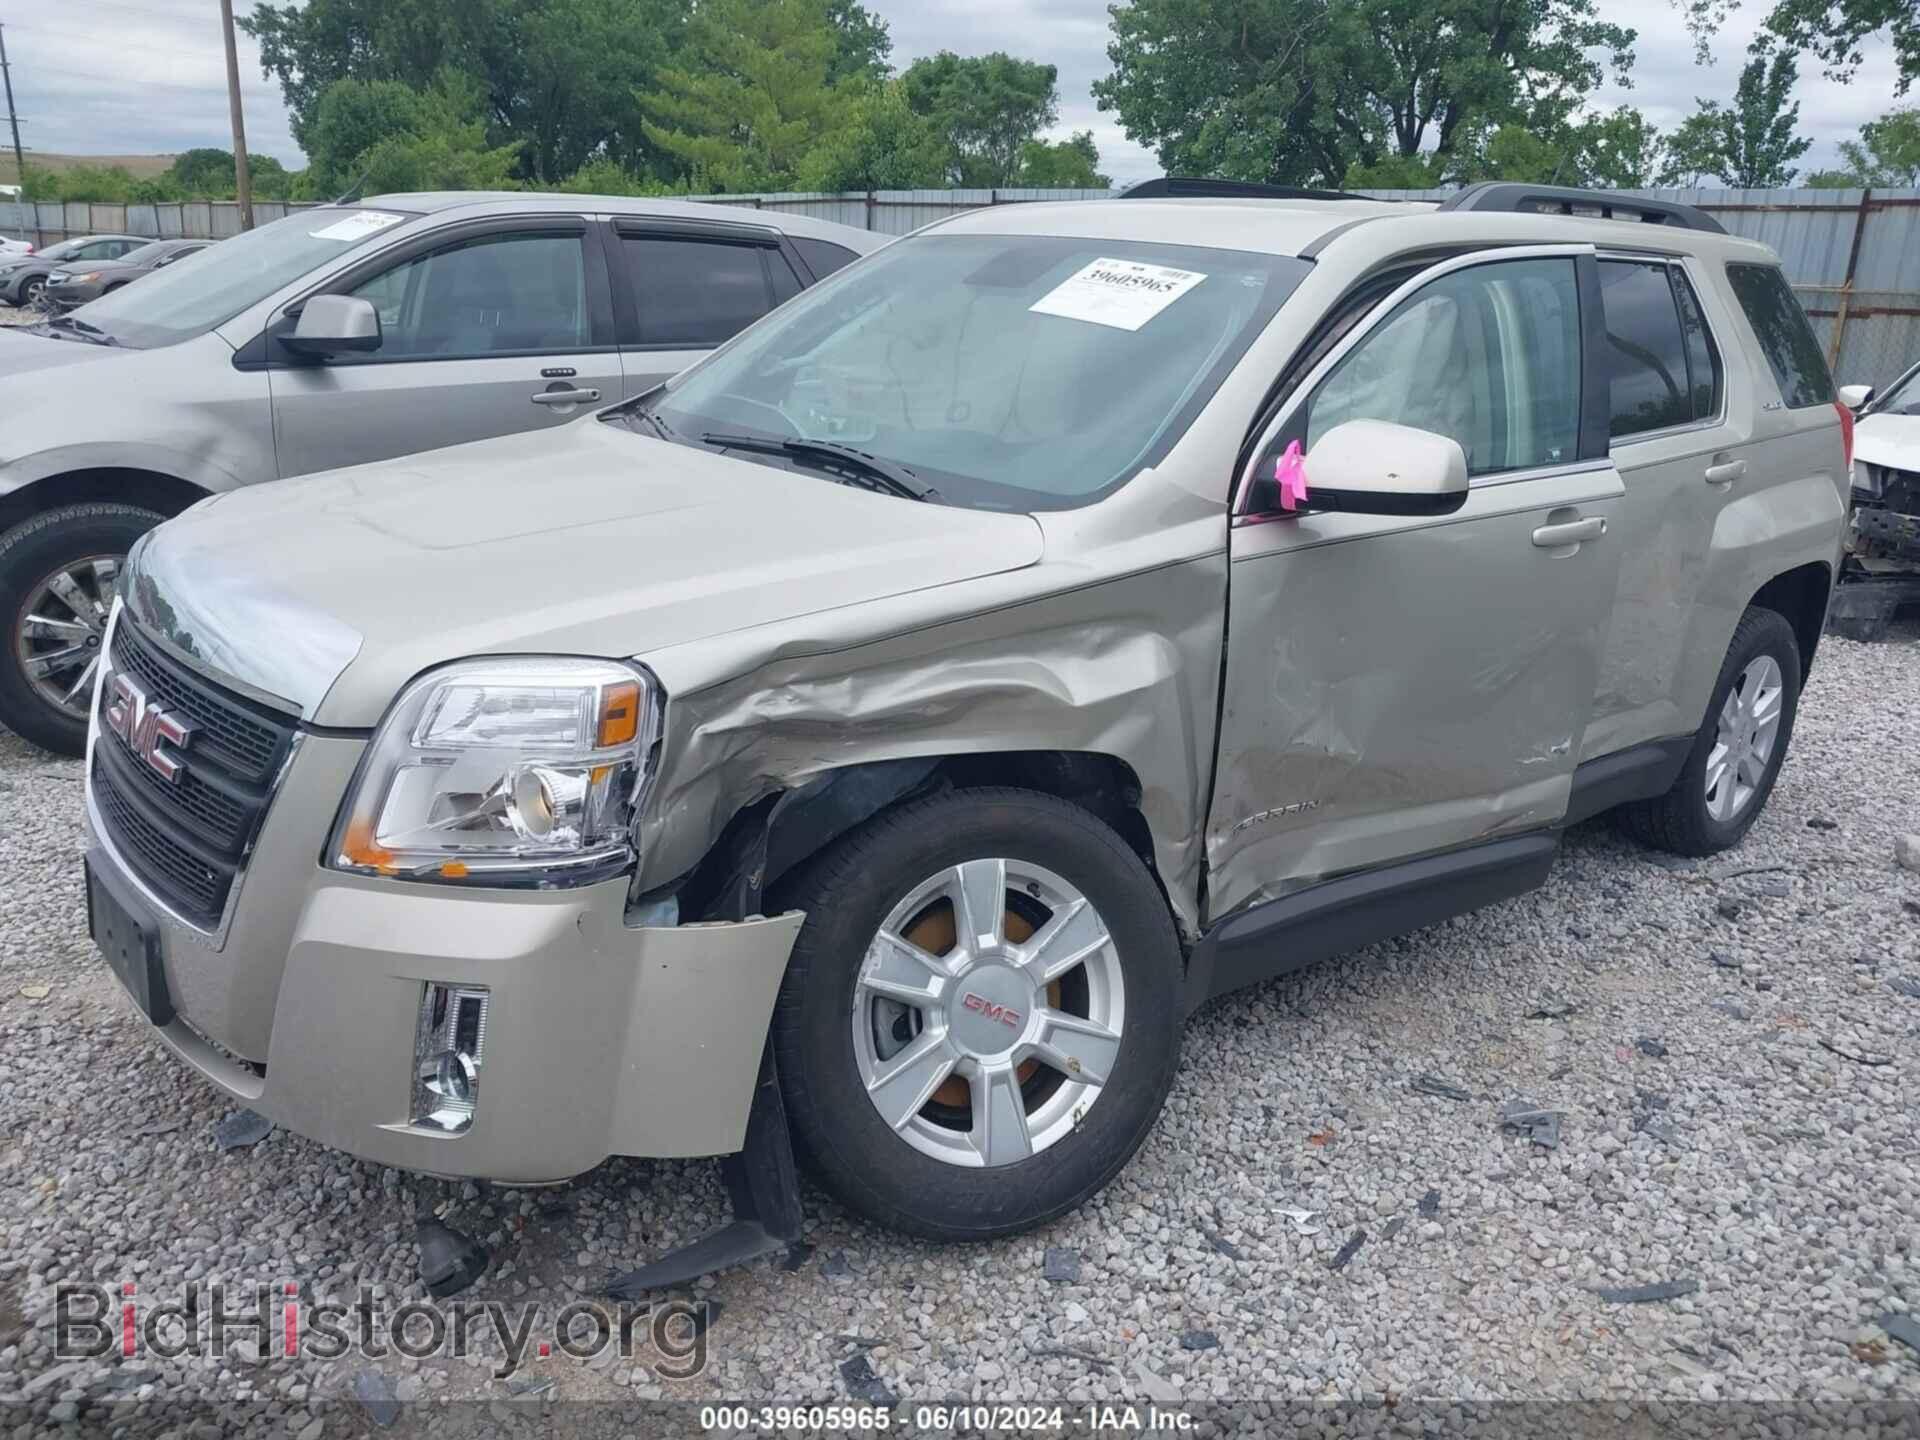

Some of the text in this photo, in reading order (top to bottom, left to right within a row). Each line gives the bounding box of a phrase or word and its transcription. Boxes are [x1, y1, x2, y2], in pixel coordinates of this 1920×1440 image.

[1083, 269, 1177, 293] 39605965
[105, 673, 190, 784] GMC
[963, 992, 1022, 1027] GMC
